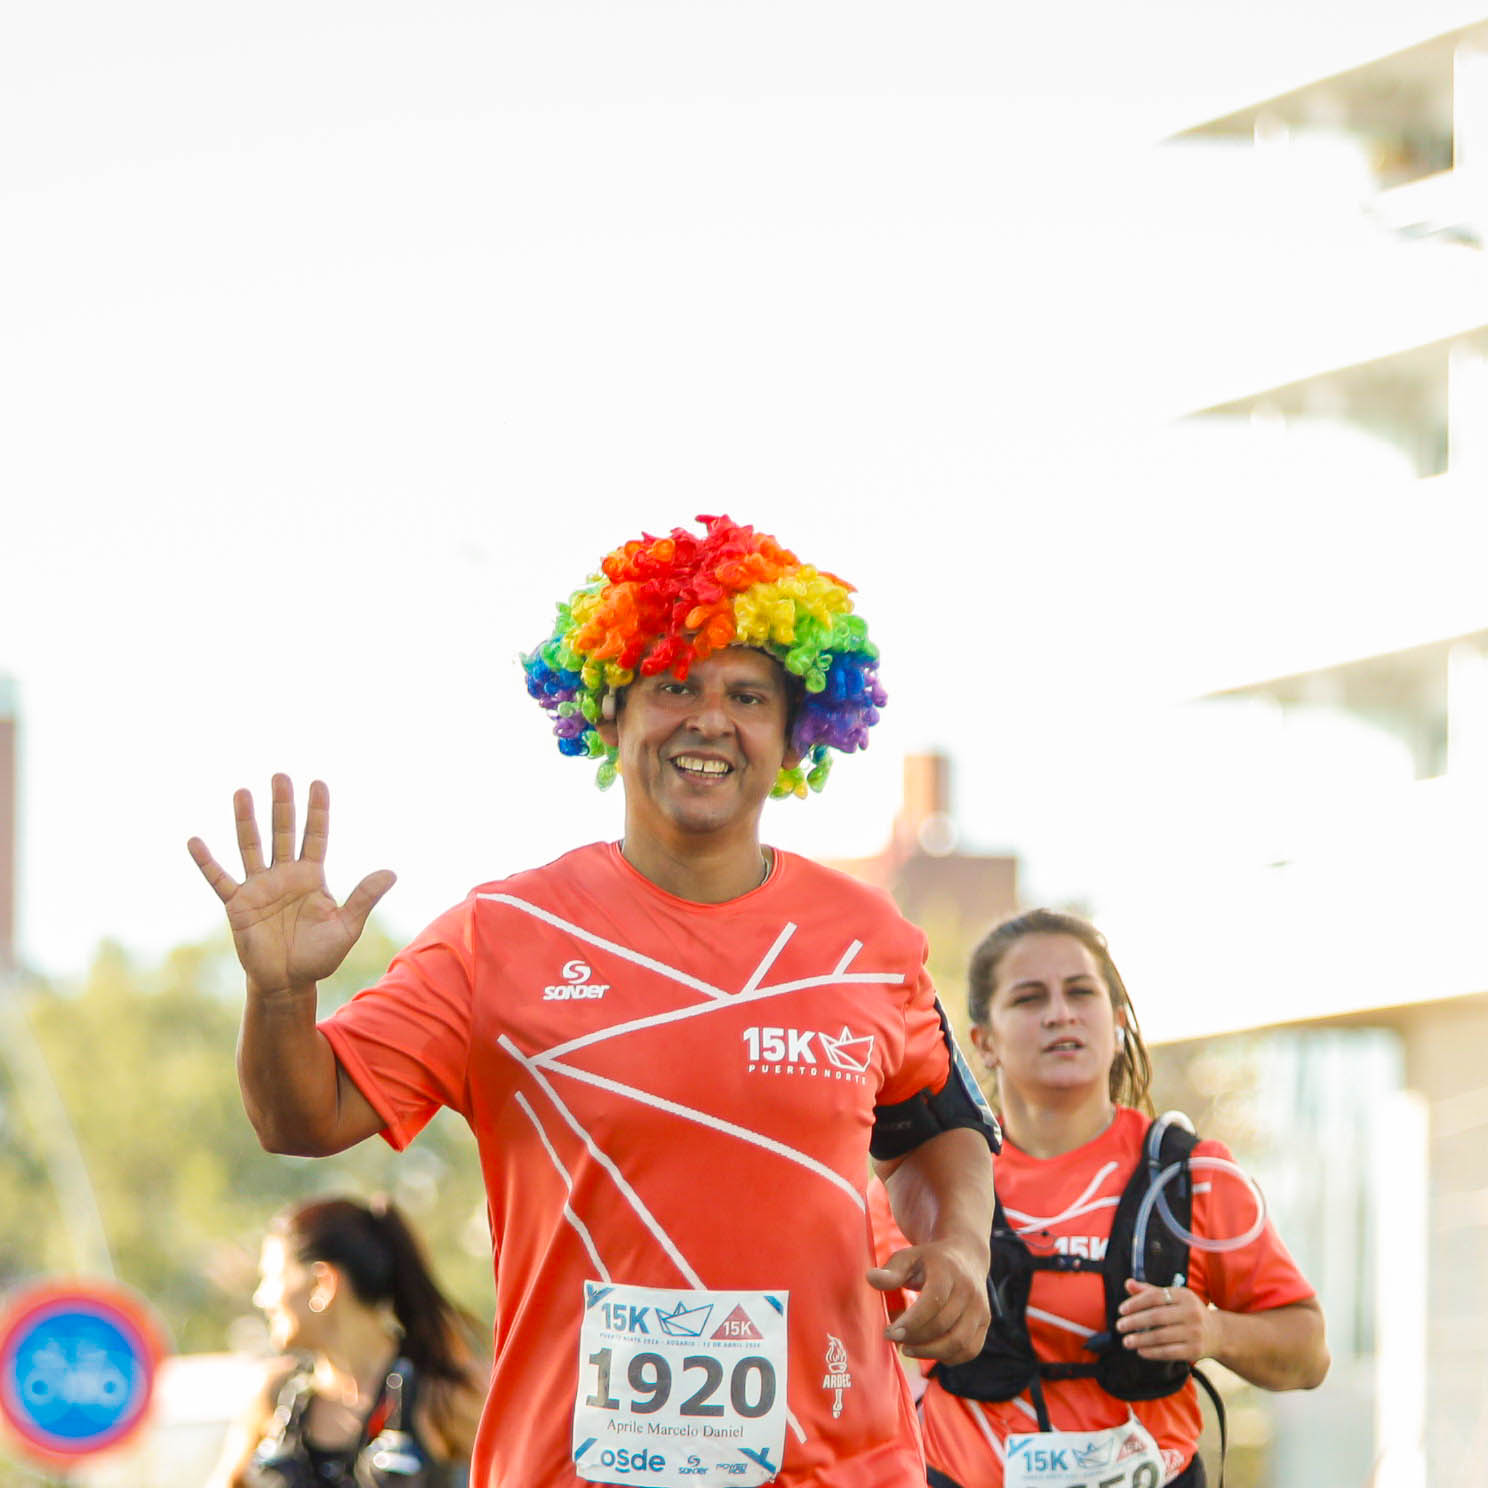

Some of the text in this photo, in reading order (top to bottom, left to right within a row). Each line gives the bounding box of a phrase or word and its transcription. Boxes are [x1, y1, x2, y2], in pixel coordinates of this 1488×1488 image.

[743, 1026, 817, 1064] 15K
[748, 1064, 817, 1076] PUERTO
[601, 1301, 650, 1335] 15K
[723, 1320, 752, 1337] 15K
[586, 1347, 777, 1419] 1920
[607, 1418, 744, 1438] Aprile Marcelo Daniel
[600, 1447, 666, 1473] osde
[1023, 1450, 1069, 1473] 15K
